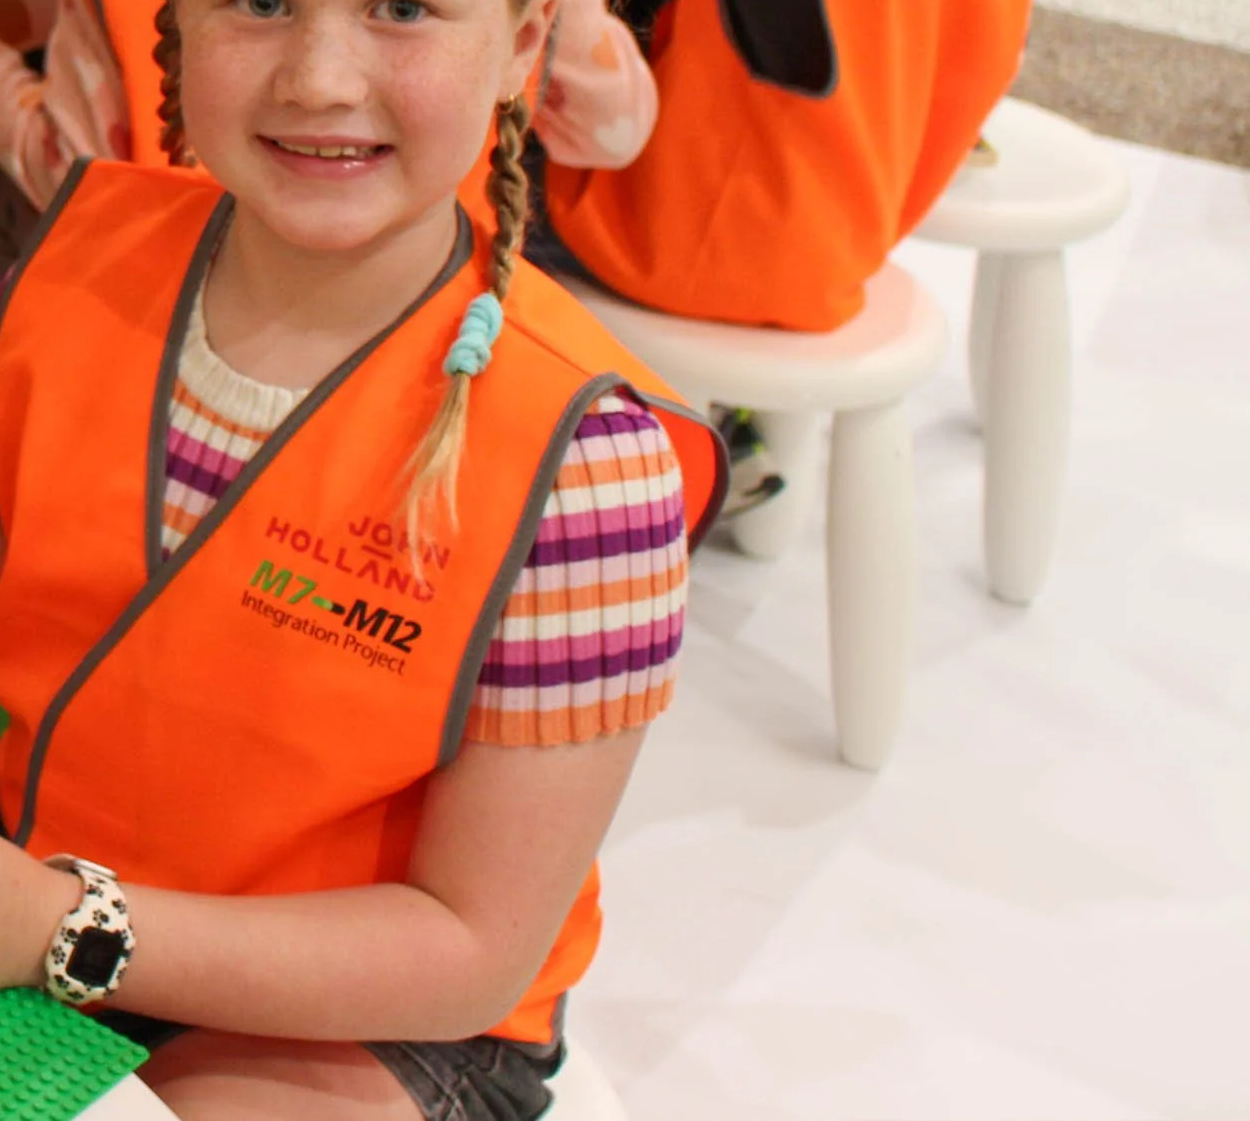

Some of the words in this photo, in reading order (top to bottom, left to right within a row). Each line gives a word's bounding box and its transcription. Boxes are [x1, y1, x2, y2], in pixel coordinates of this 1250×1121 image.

[265, 516, 435, 603] HOLLAND
[241, 589, 340, 647] Integration
[342, 633, 406, 676] Project
